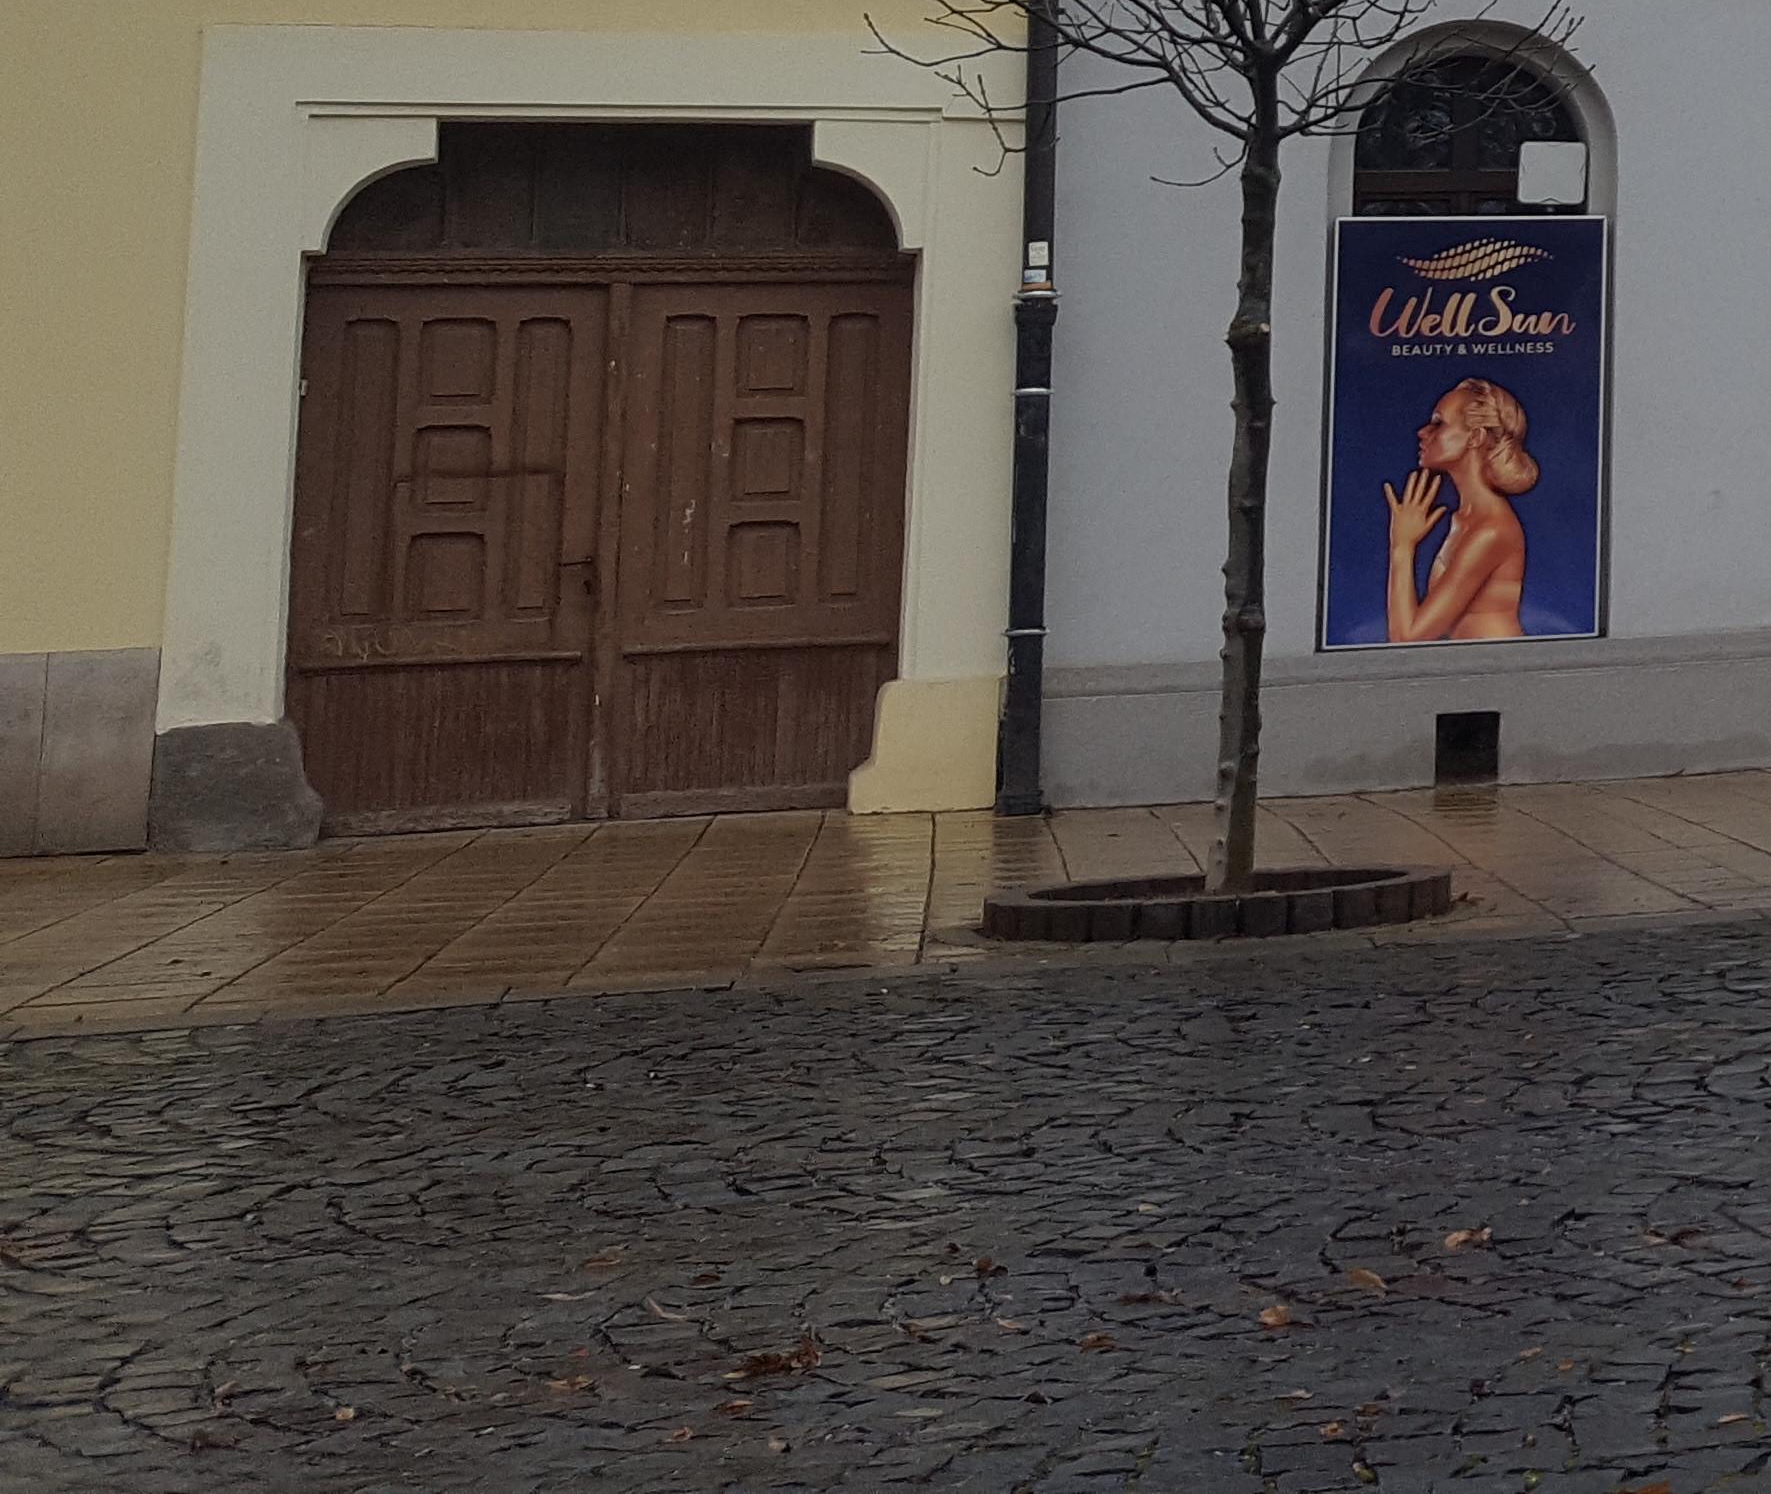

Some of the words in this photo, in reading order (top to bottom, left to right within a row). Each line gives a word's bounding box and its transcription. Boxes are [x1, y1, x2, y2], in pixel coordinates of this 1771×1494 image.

[1391, 343, 1454, 357] BEAUTY
[1457, 343, 1468, 355] &
[1472, 342, 1555, 355] WELLNESS
